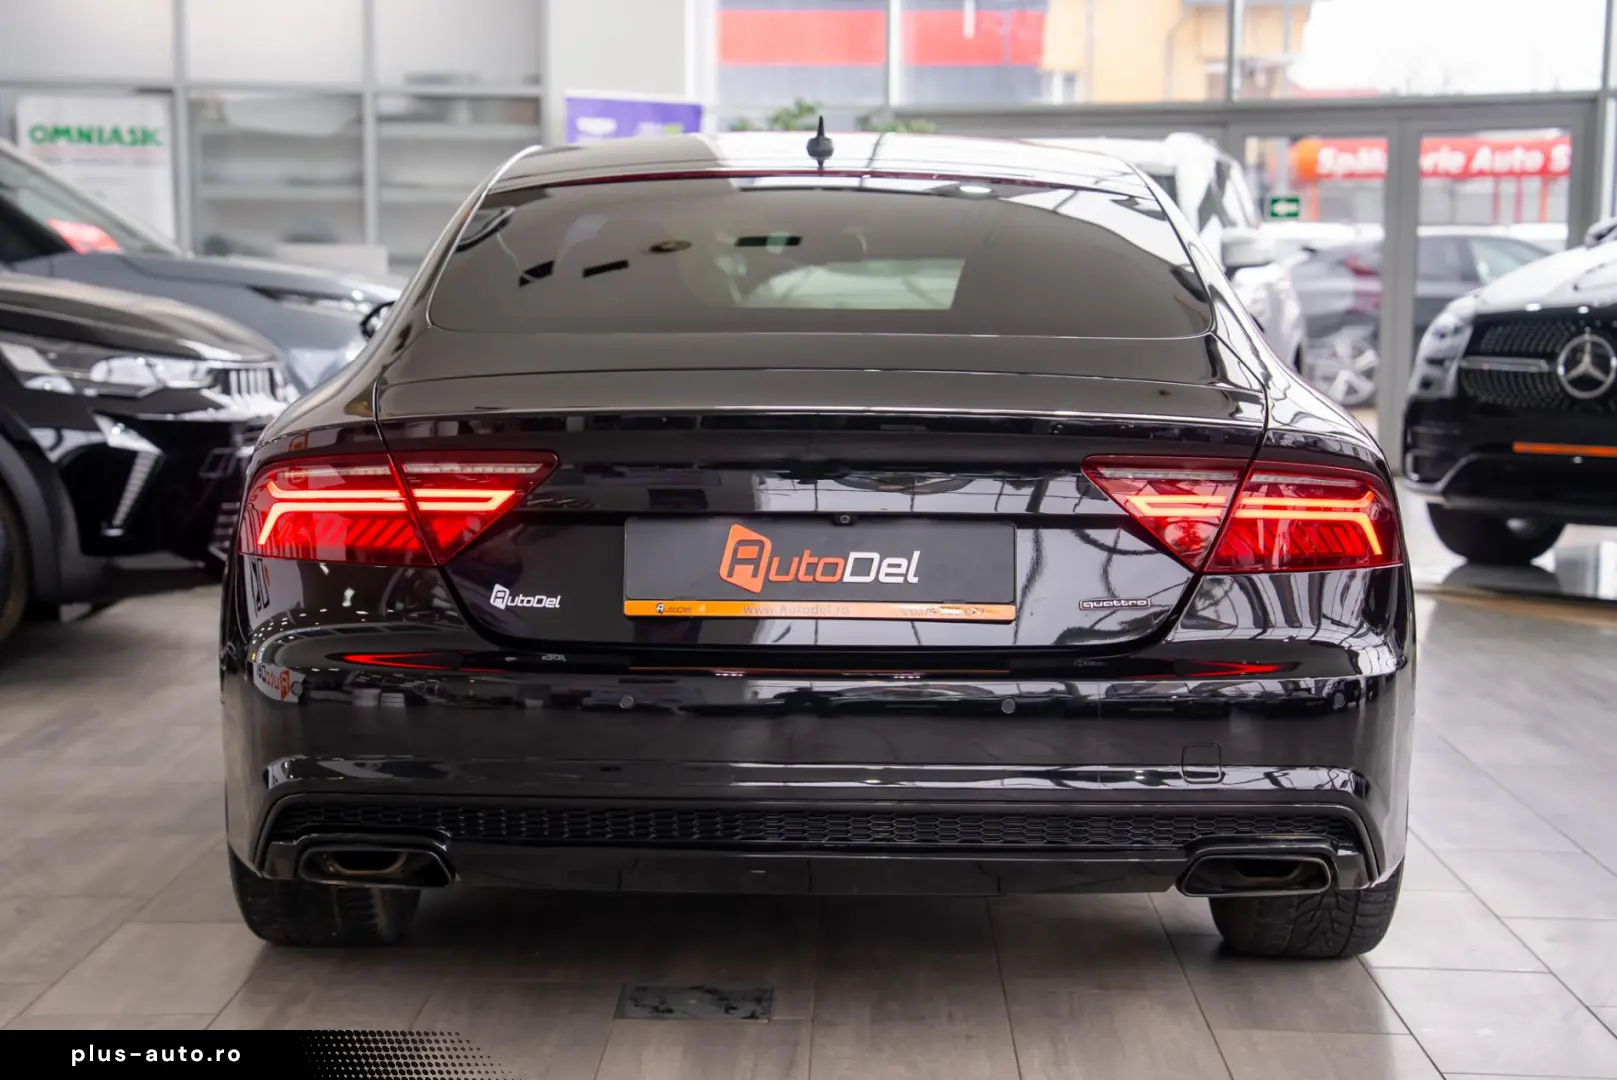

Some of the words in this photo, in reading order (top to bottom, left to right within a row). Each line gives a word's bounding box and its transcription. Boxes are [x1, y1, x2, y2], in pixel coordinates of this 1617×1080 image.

[1469, 145, 1545, 173] Auto
[719, 523, 921, 593] AutoDel
[490, 583, 561, 610] AutoDel
[1083, 600, 1147, 609] quattro
